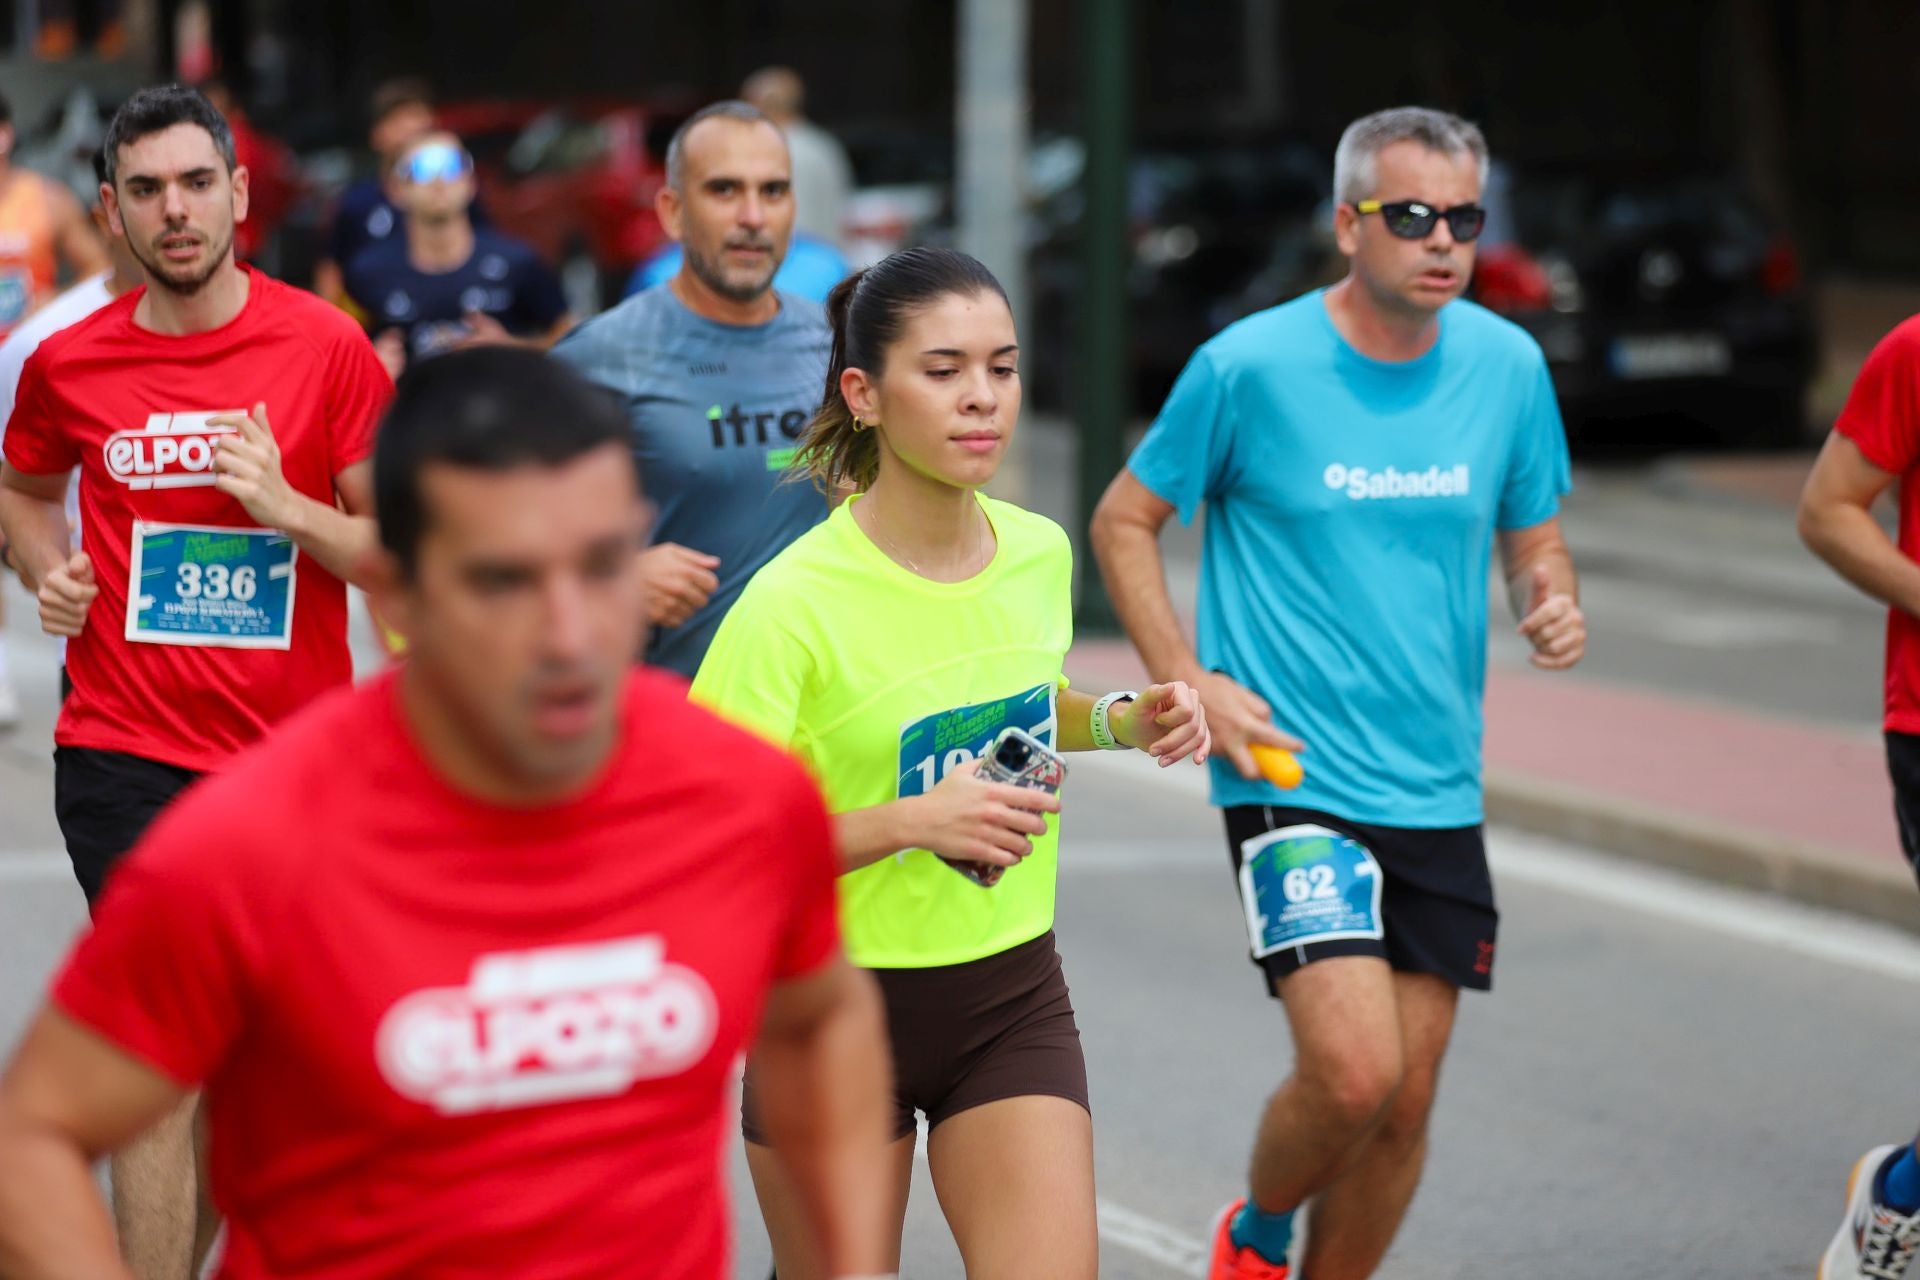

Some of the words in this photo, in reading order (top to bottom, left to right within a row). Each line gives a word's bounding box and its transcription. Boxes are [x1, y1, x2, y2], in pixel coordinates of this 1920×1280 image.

[706, 402, 819, 447] itre
[1346, 464, 1469, 499] Sabadell
[175, 562, 257, 602] 336
[1283, 864, 1338, 903] 62
